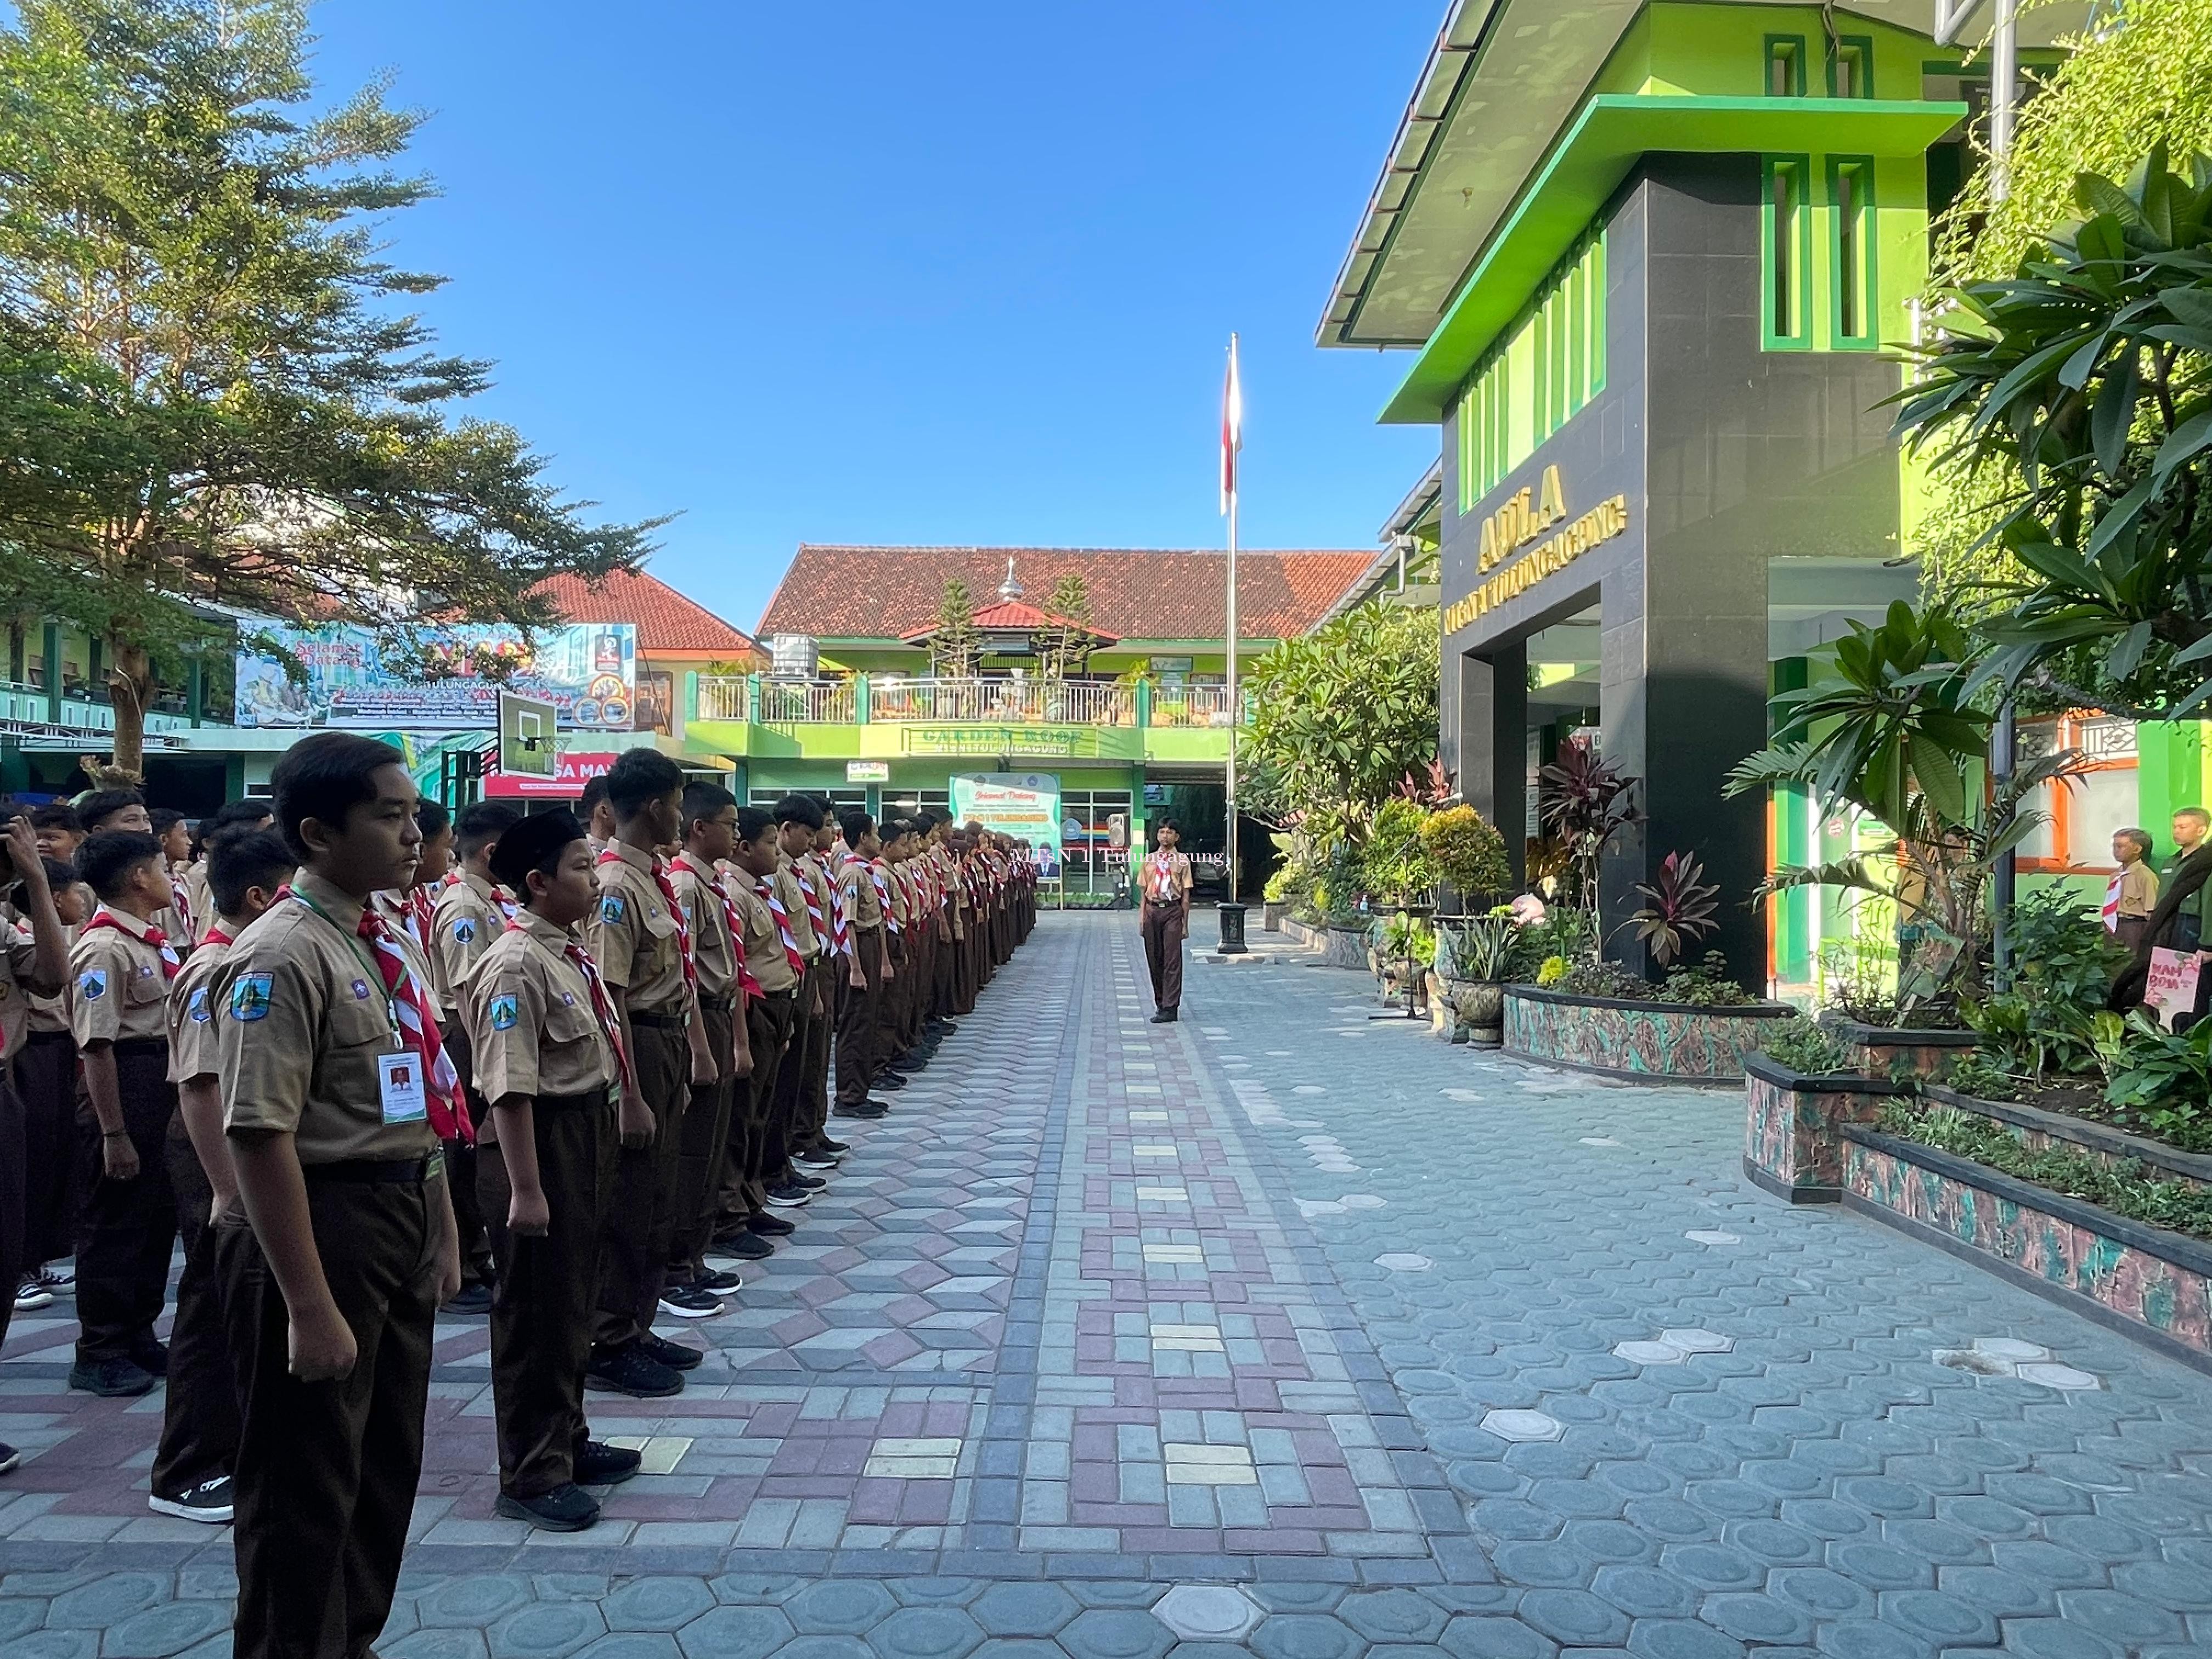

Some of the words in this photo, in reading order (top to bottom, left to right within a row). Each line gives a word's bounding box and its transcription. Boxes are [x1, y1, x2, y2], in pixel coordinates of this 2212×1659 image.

[1476, 464, 1566, 574] AULA
[1487, 494, 1627, 608] TULUNGAGUNG
[295, 641, 362, 654] Selamat
[303, 653, 360, 668] Datang
[923, 730, 1011, 742] GARDEN
[1024, 730, 1083, 743] ROOF
[580, 764, 611, 778] MA
[975, 791, 1006, 799] Selamat
[1008, 791, 1036, 802] Datang
